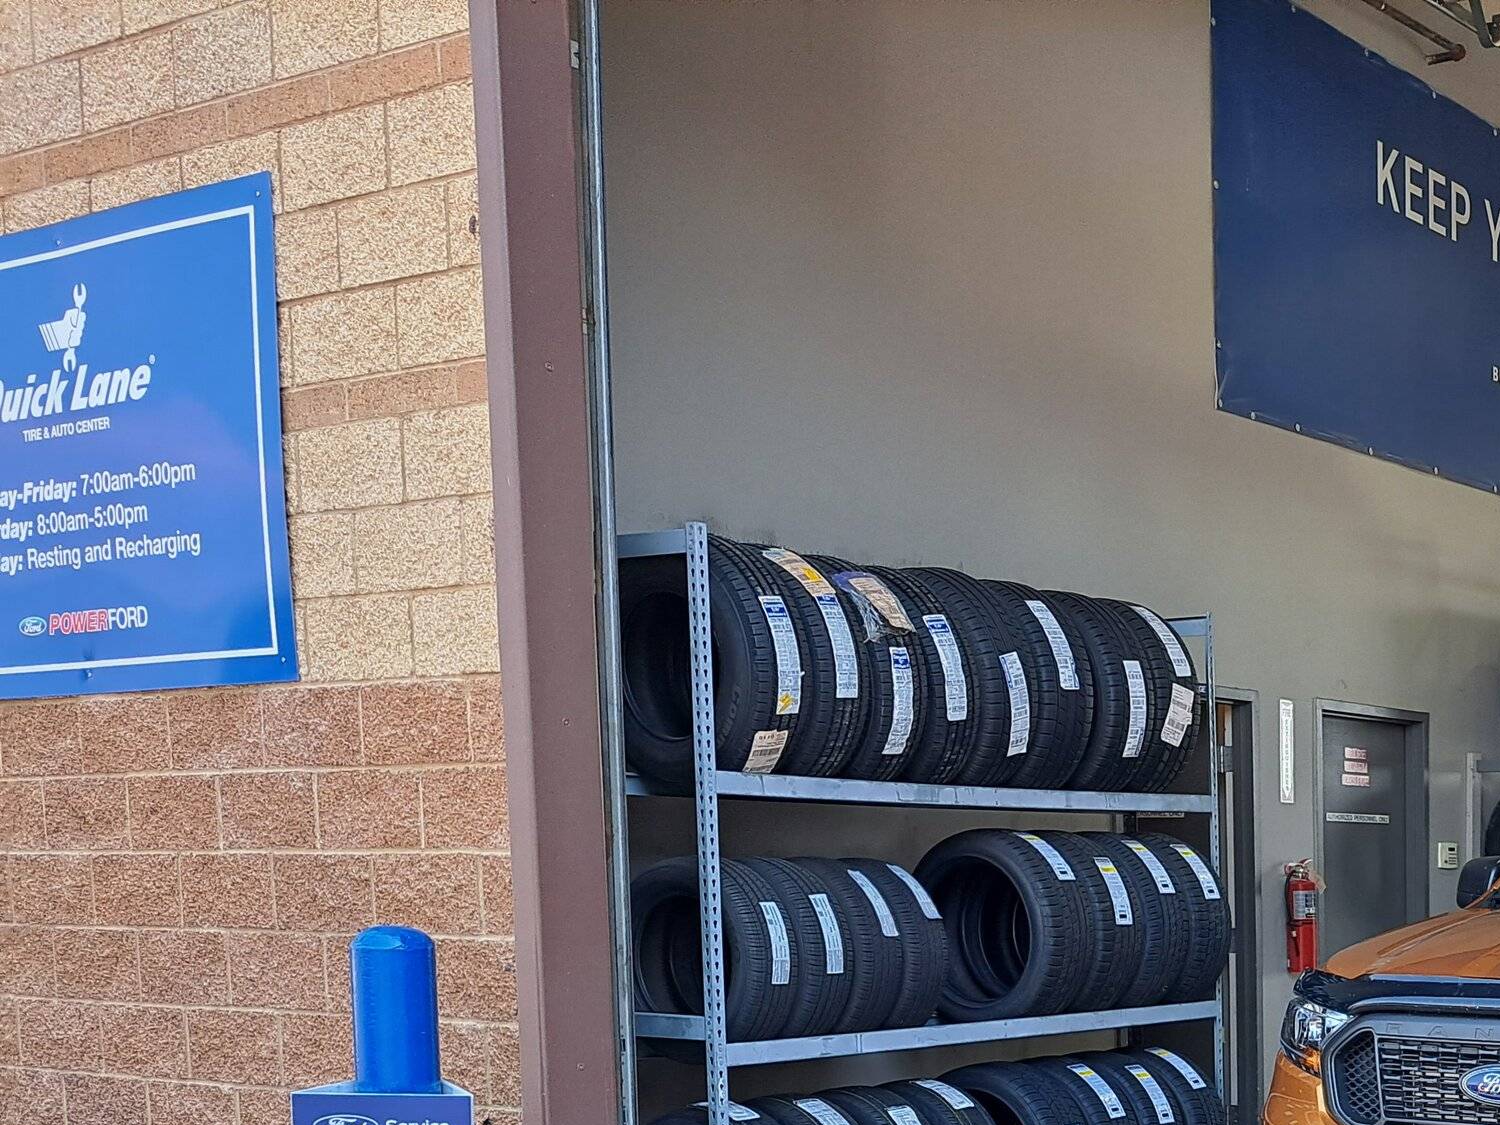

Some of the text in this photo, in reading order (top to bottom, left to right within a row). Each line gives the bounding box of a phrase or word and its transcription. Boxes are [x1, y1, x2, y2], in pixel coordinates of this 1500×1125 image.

[1376, 139, 1472, 242] KEEP
[0, 369, 69, 423] uick
[22, 416, 110, 442] TIRE & AUTO CENTER
[80, 462, 195, 495] 7:00am-6:00pm
[0, 503, 148, 541] day: 8:00am-5:00pm
[27, 545, 81, 569] Resting
[85, 539, 111, 562] and
[115, 530, 200, 559] Recharging
